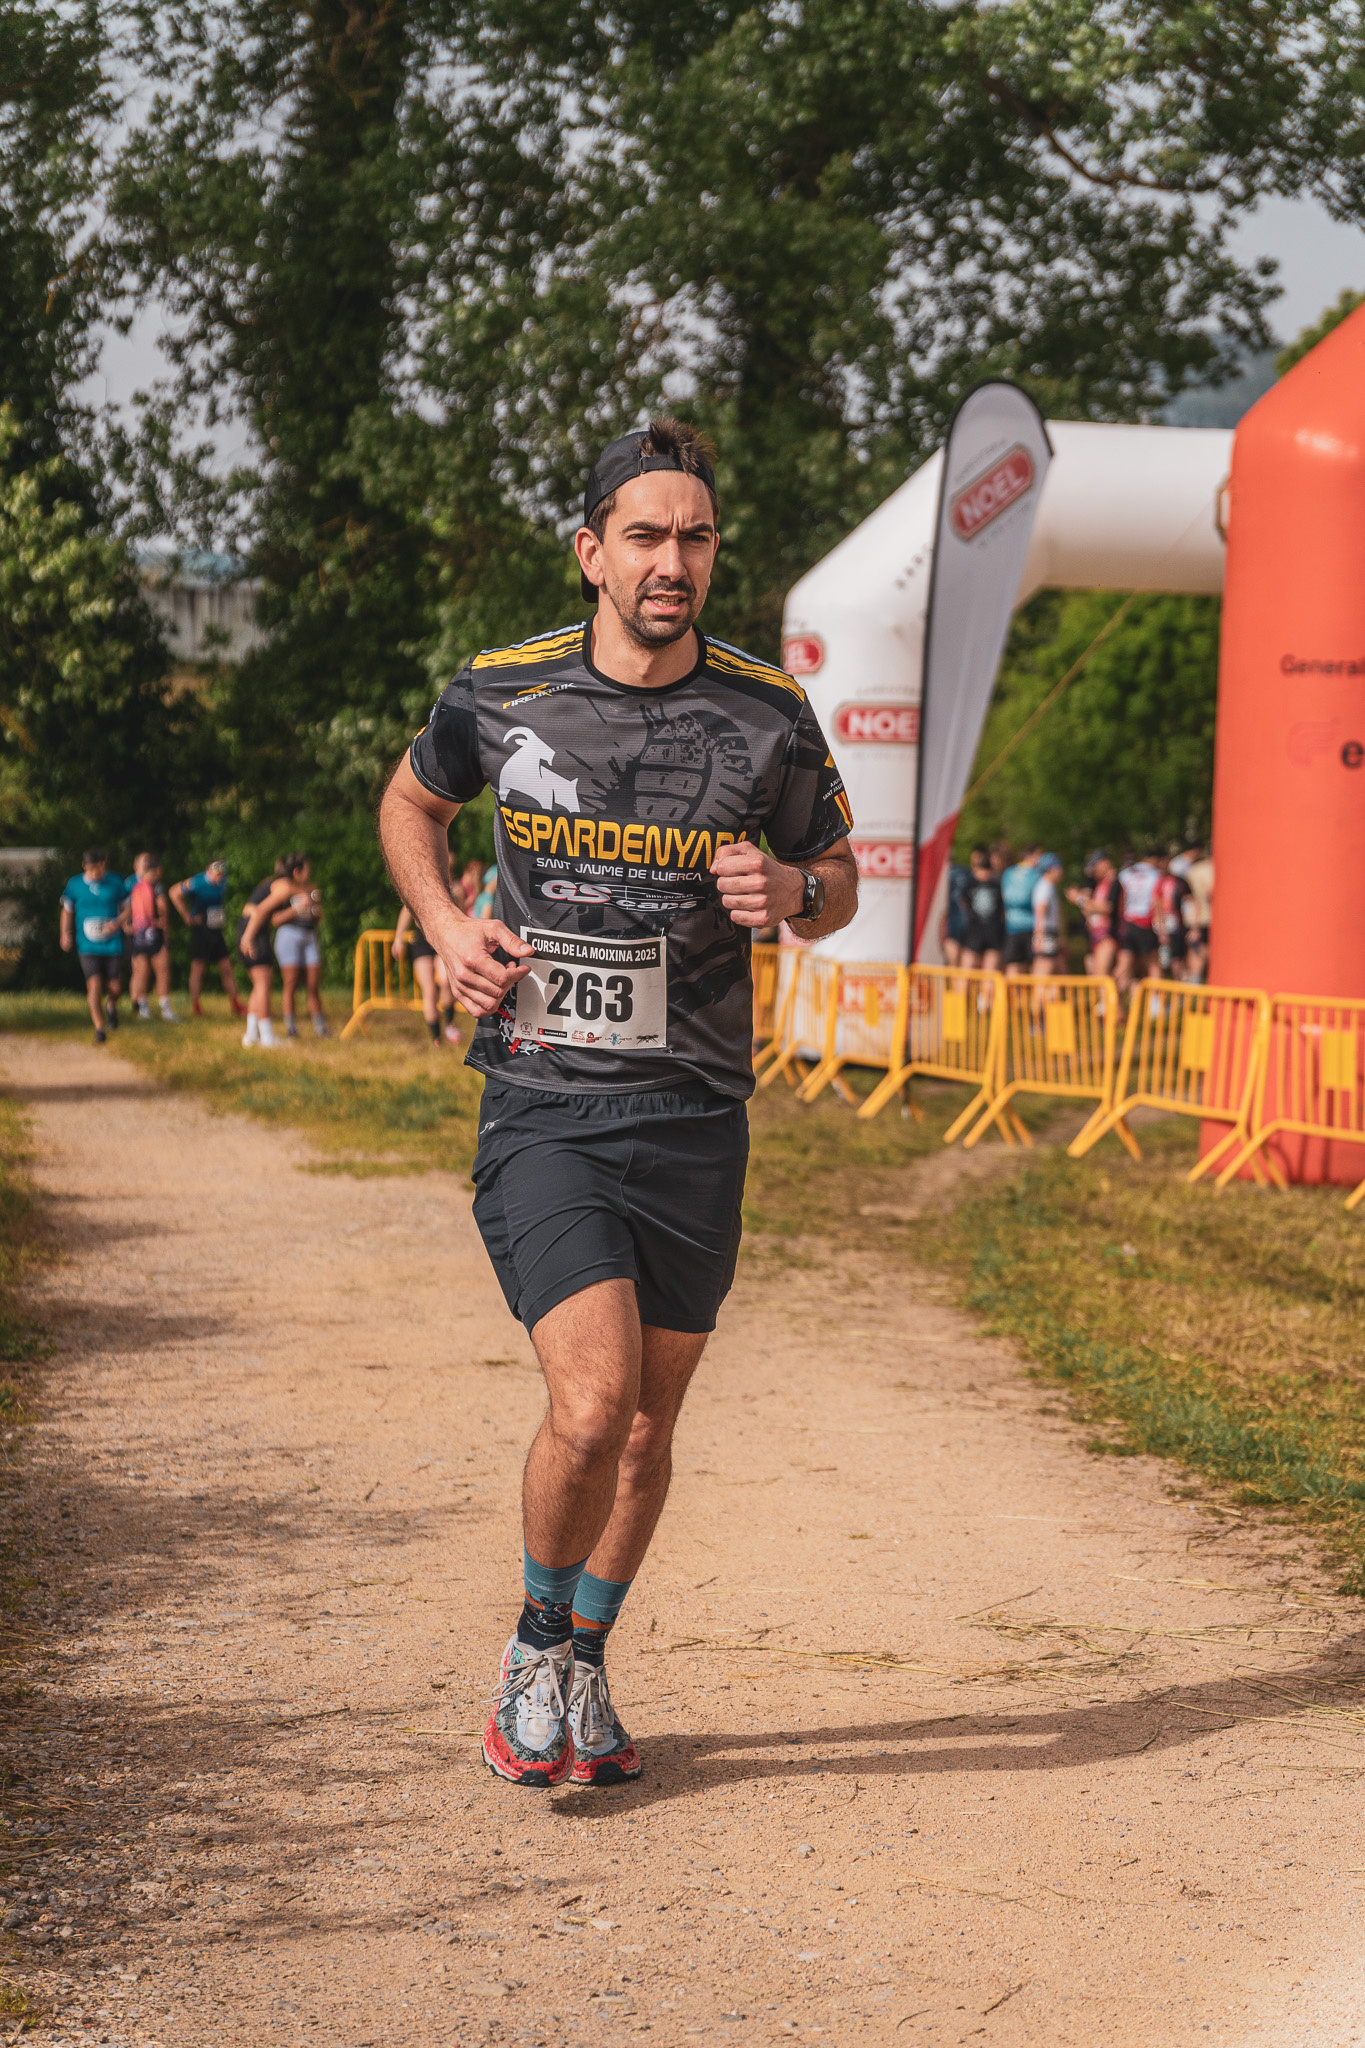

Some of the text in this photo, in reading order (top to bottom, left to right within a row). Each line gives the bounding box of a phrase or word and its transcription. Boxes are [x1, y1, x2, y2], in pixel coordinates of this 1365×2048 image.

[961, 465, 1024, 527] NOEL
[502, 682, 577, 710] FIREHAWK
[536, 857, 702, 882] SANT JAUME DE LLIERCA
[541, 879, 612, 904] GS
[616, 899, 698, 910] cars
[531, 938, 657, 962] CURSA DE LA MOIXINA 2025
[546, 968, 634, 1023] 263
